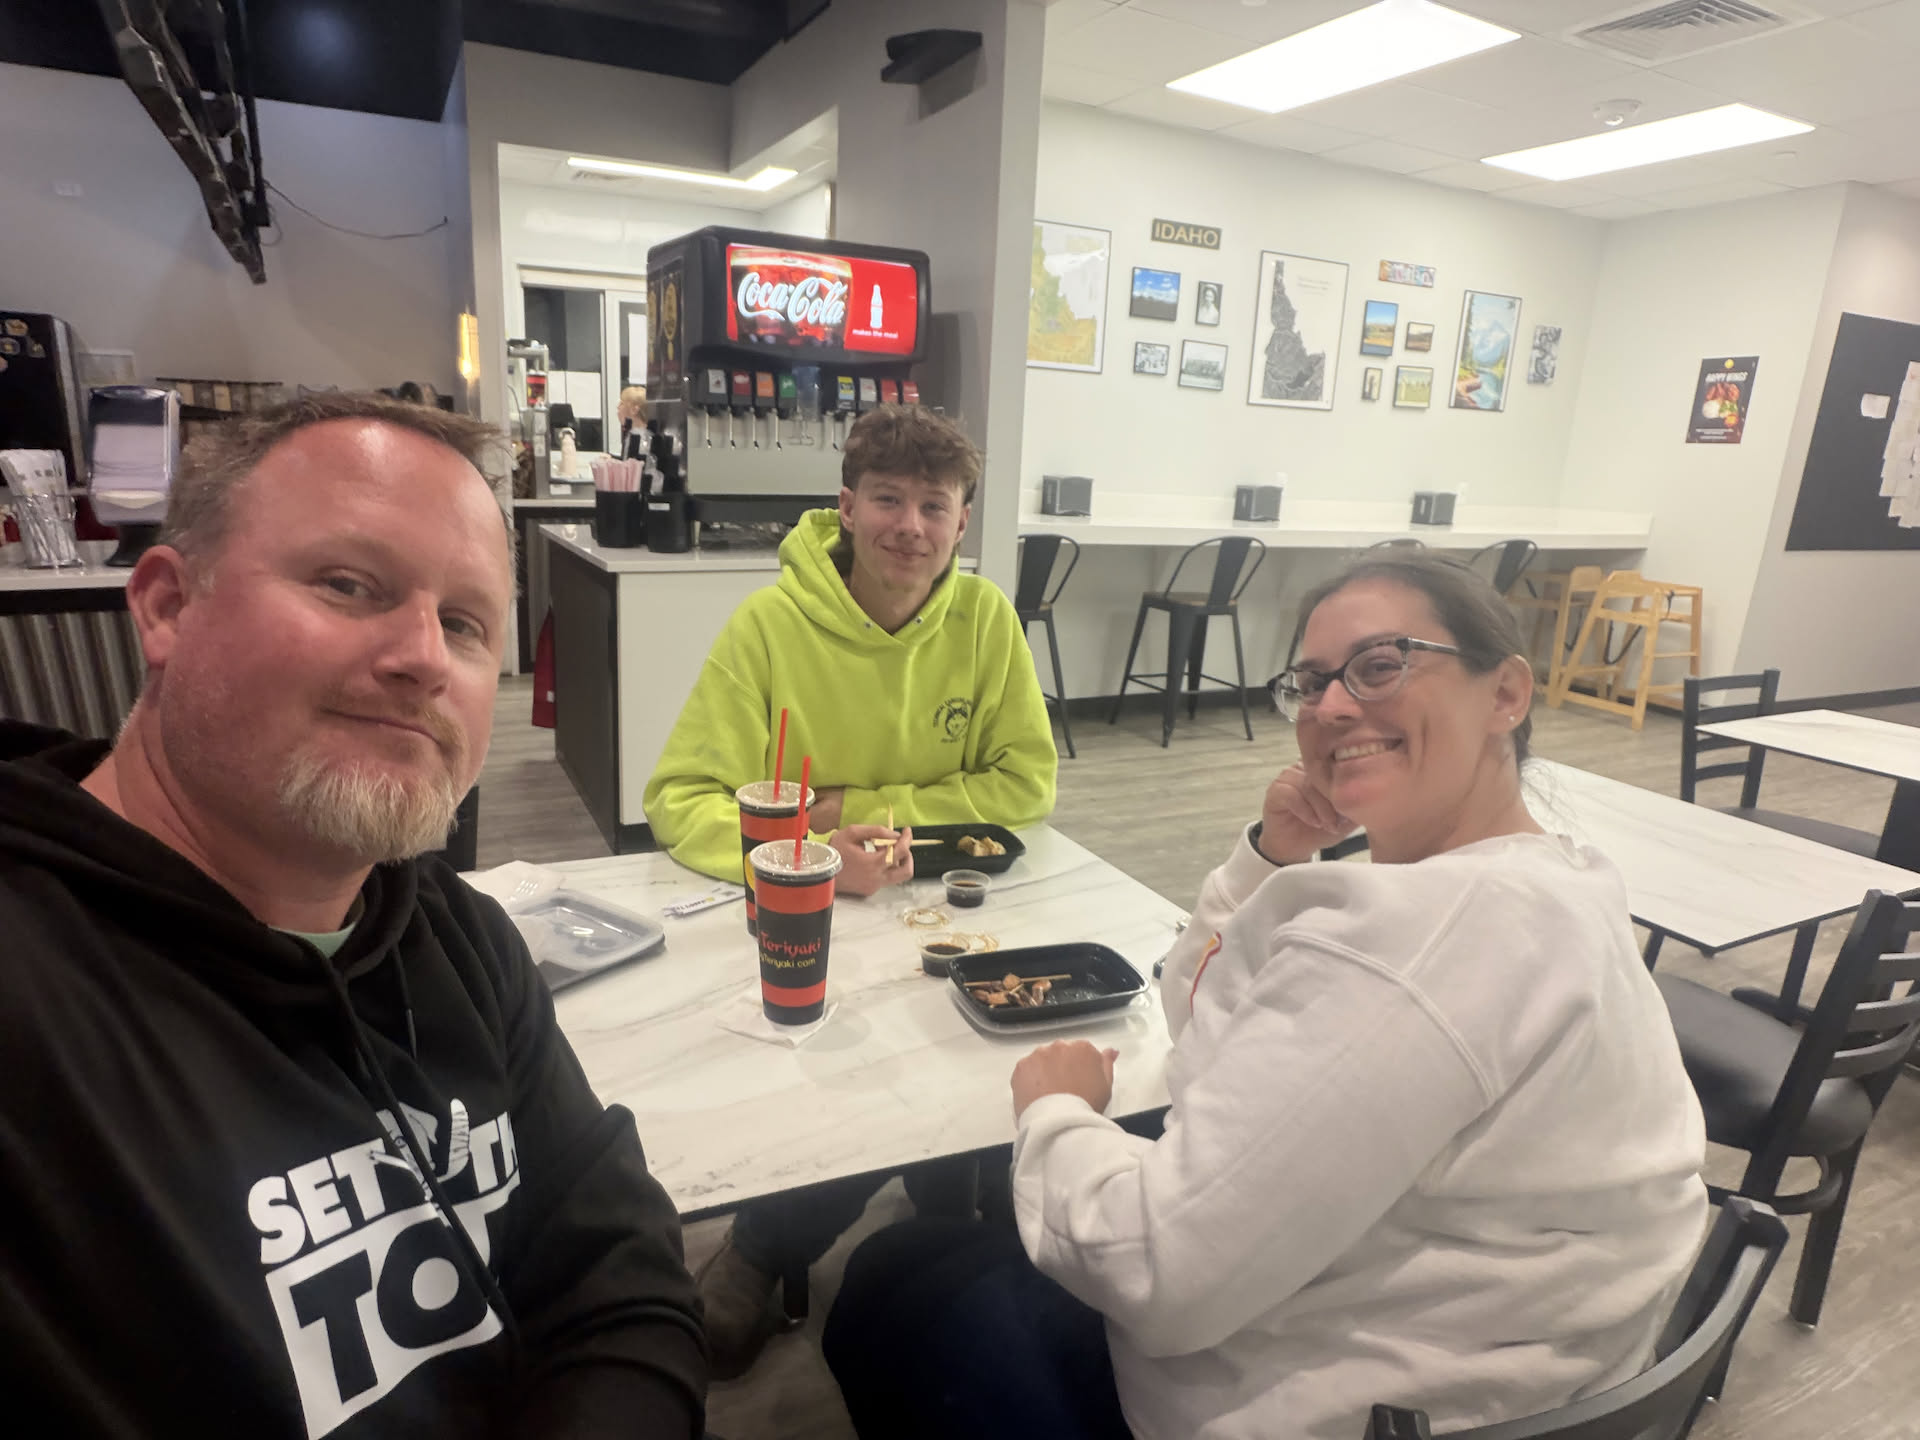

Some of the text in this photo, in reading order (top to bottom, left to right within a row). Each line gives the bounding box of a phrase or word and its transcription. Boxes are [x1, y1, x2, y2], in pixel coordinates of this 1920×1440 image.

[1154, 222, 1219, 247] IDAHO
[737, 271, 848, 325] Coca-Cola
[873, 329, 882, 337] the
[760, 930, 821, 959] Teriyaki
[248, 1137, 386, 1265] SET
